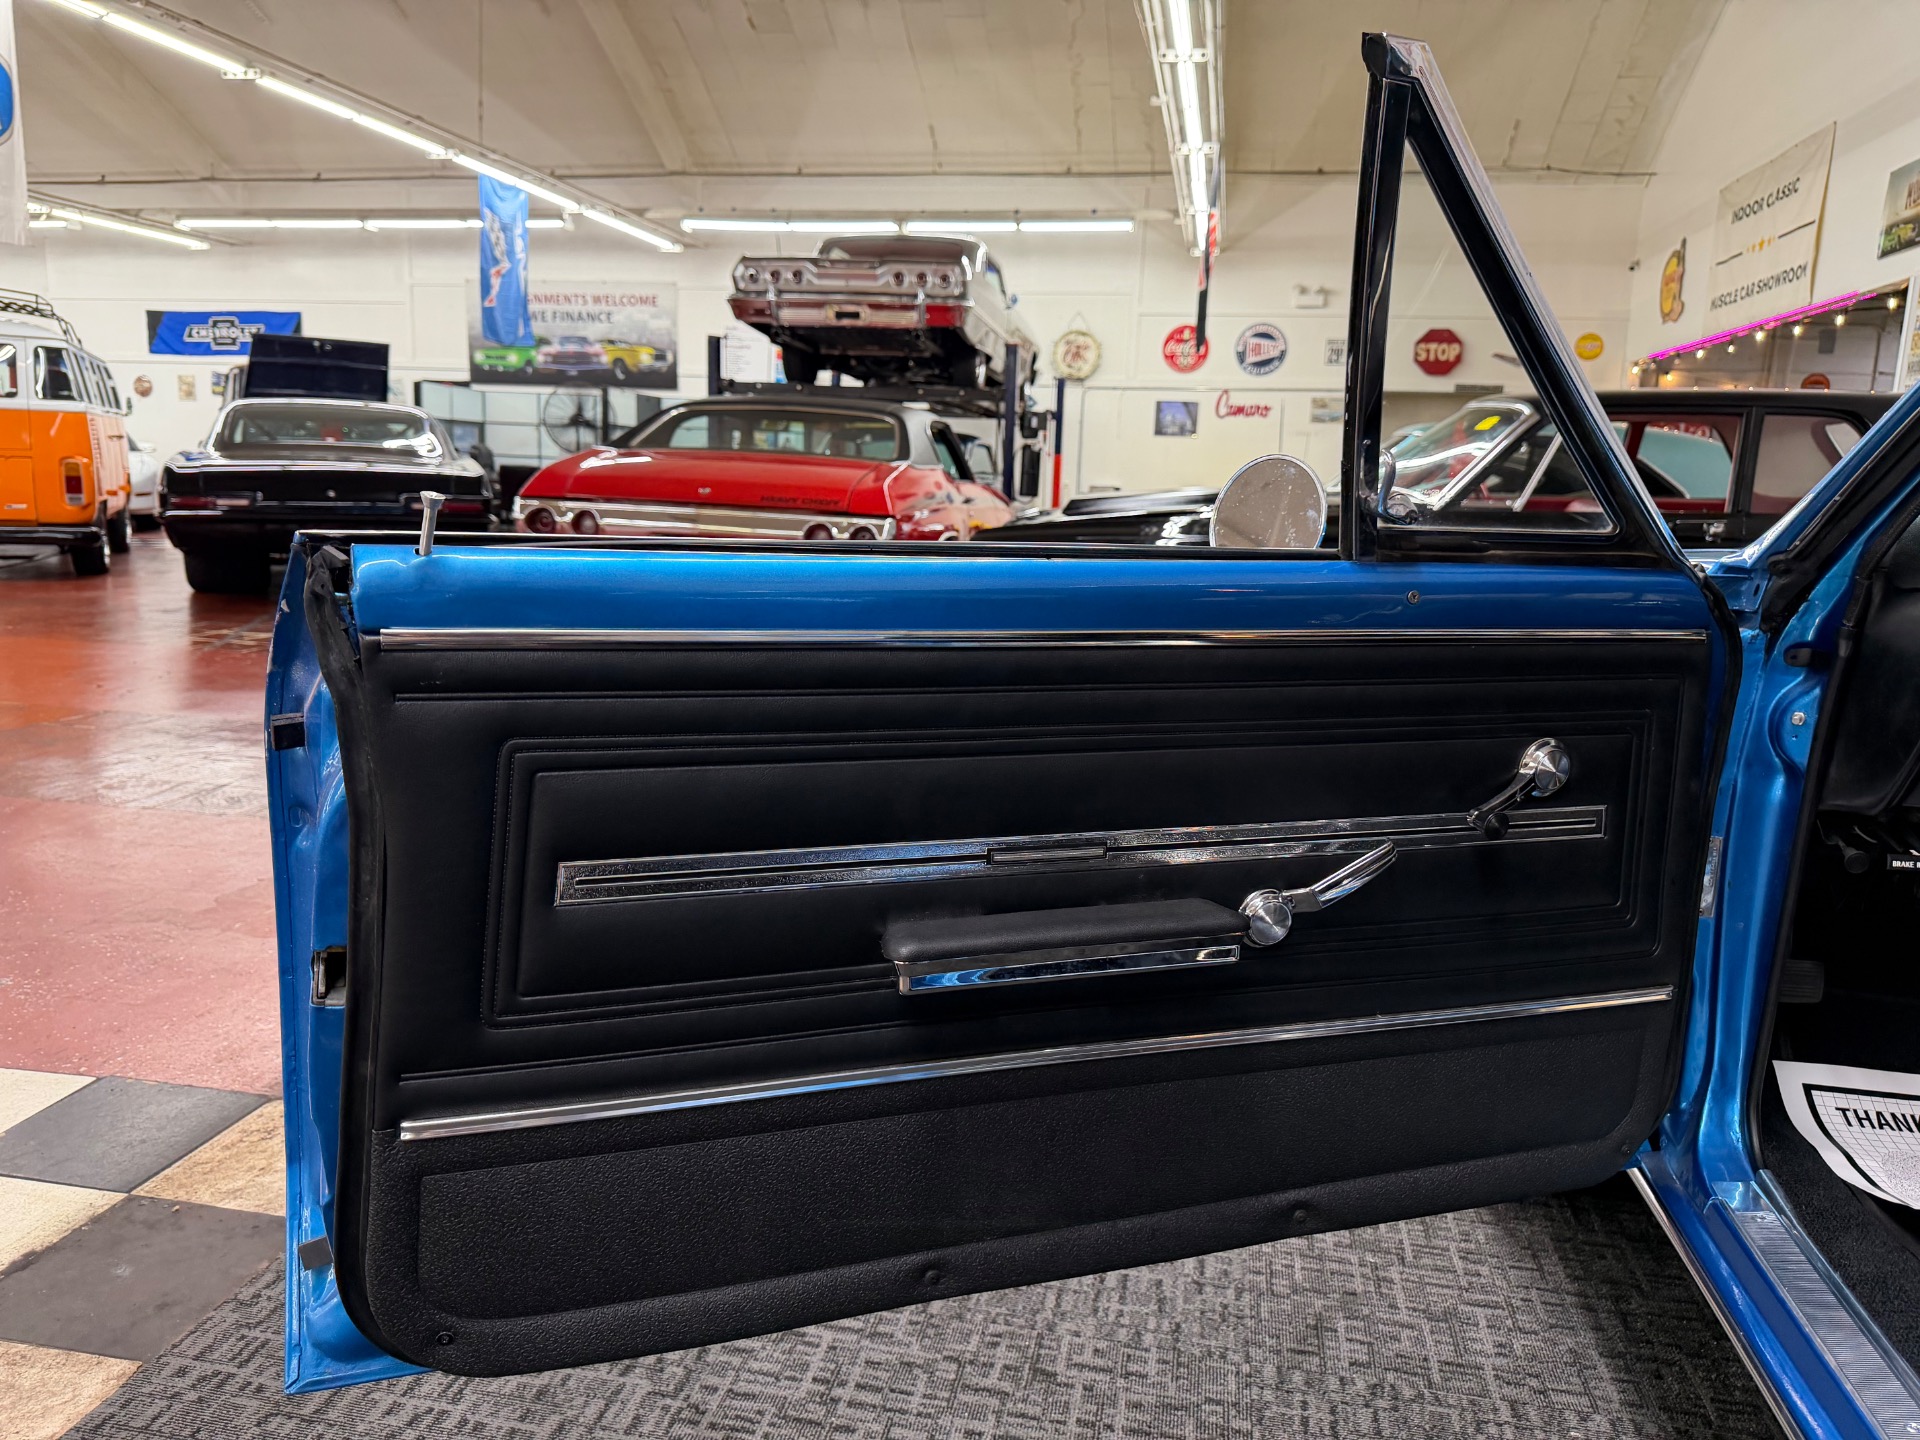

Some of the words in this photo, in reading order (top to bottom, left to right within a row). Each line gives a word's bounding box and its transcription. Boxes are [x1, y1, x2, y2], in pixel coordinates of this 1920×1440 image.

[1731, 199, 1764, 224] INDOOR
[1766, 177, 1800, 209] CLASSIC
[1710, 288, 1739, 311] MUSCLE
[1740, 282, 1755, 301] CAR
[1756, 262, 1809, 293] SHOWROOM
[592, 294, 659, 308] WELCOME
[552, 310, 615, 324] FINANCE
[1416, 341, 1462, 363] STOP
[1215, 389, 1272, 419] Camaro
[1892, 860, 1915, 868] BRAKE
